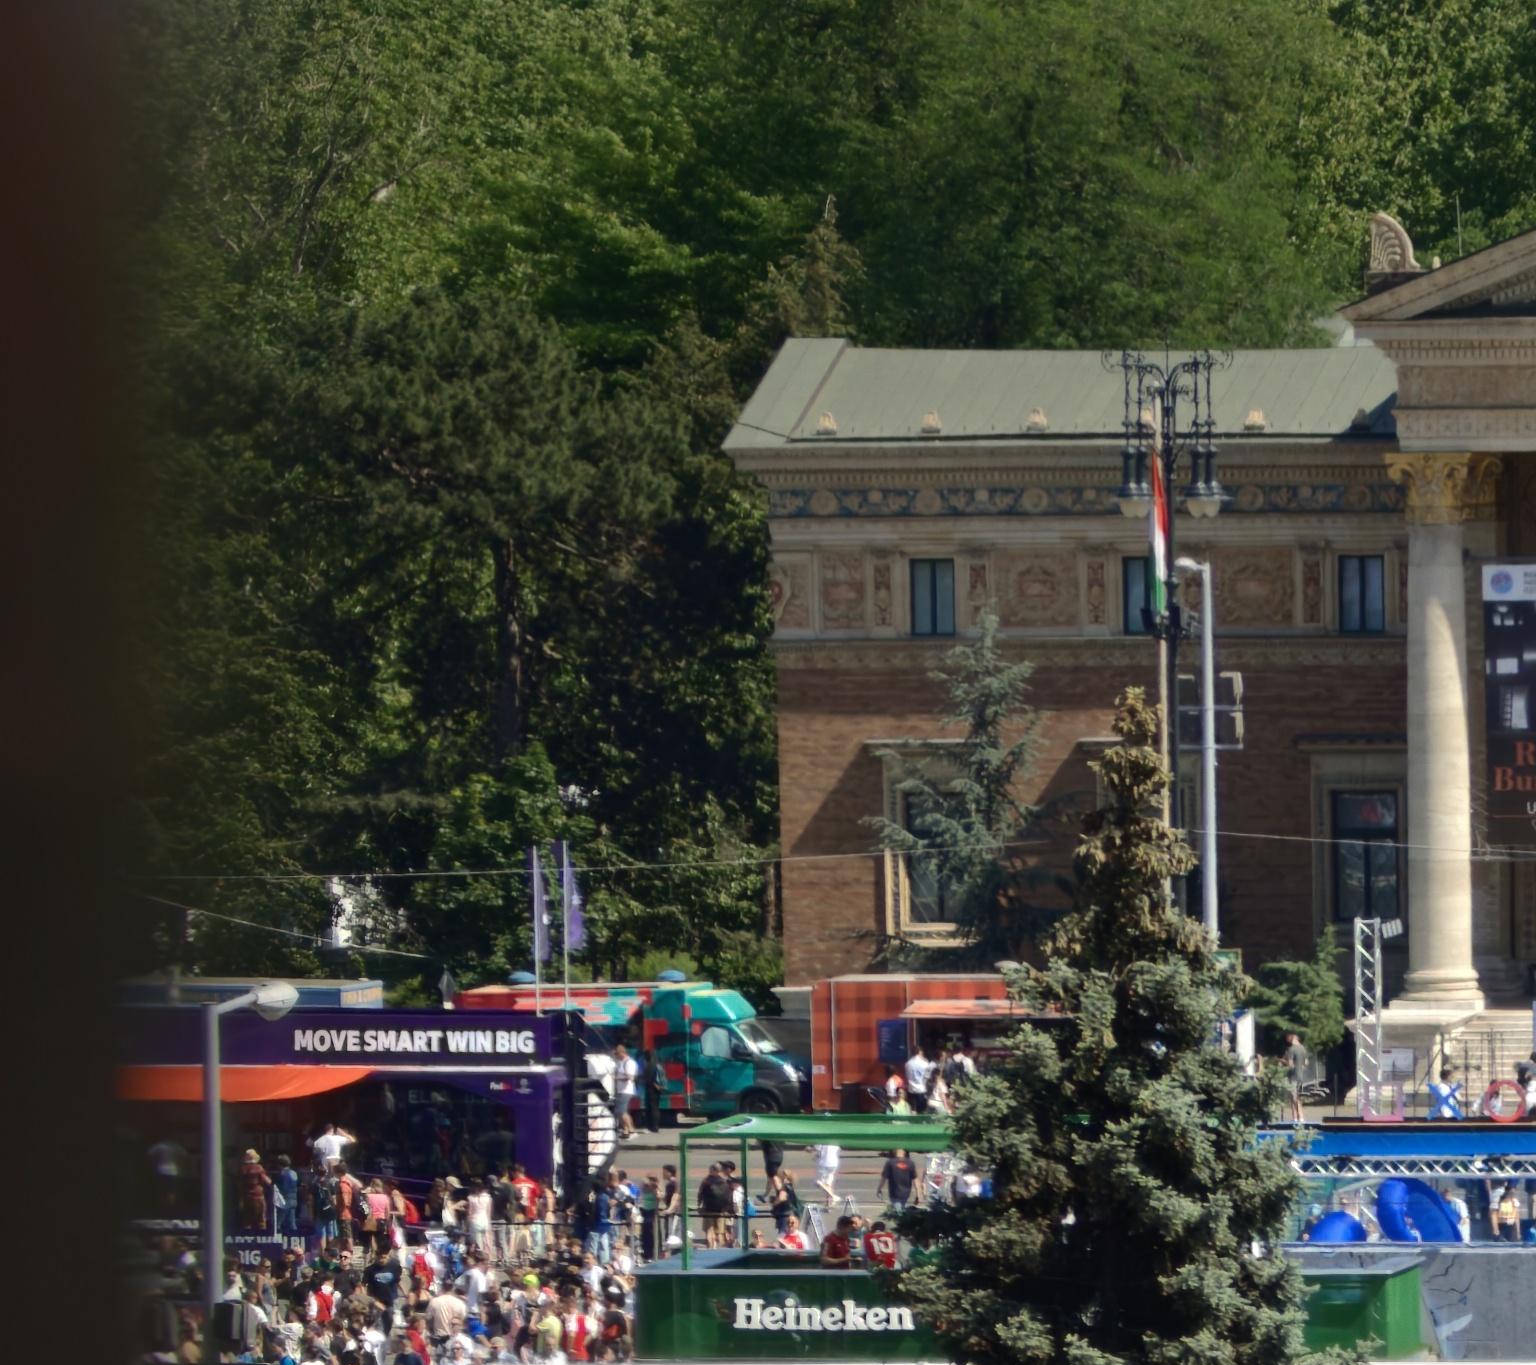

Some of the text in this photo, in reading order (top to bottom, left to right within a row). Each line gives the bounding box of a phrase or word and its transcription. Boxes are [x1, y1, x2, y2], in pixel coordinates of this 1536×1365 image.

[294, 1030, 535, 1054] MOVE SMART WIN BIG
[870, 1237, 894, 1255] 10
[733, 1298, 916, 1331] Heineken
